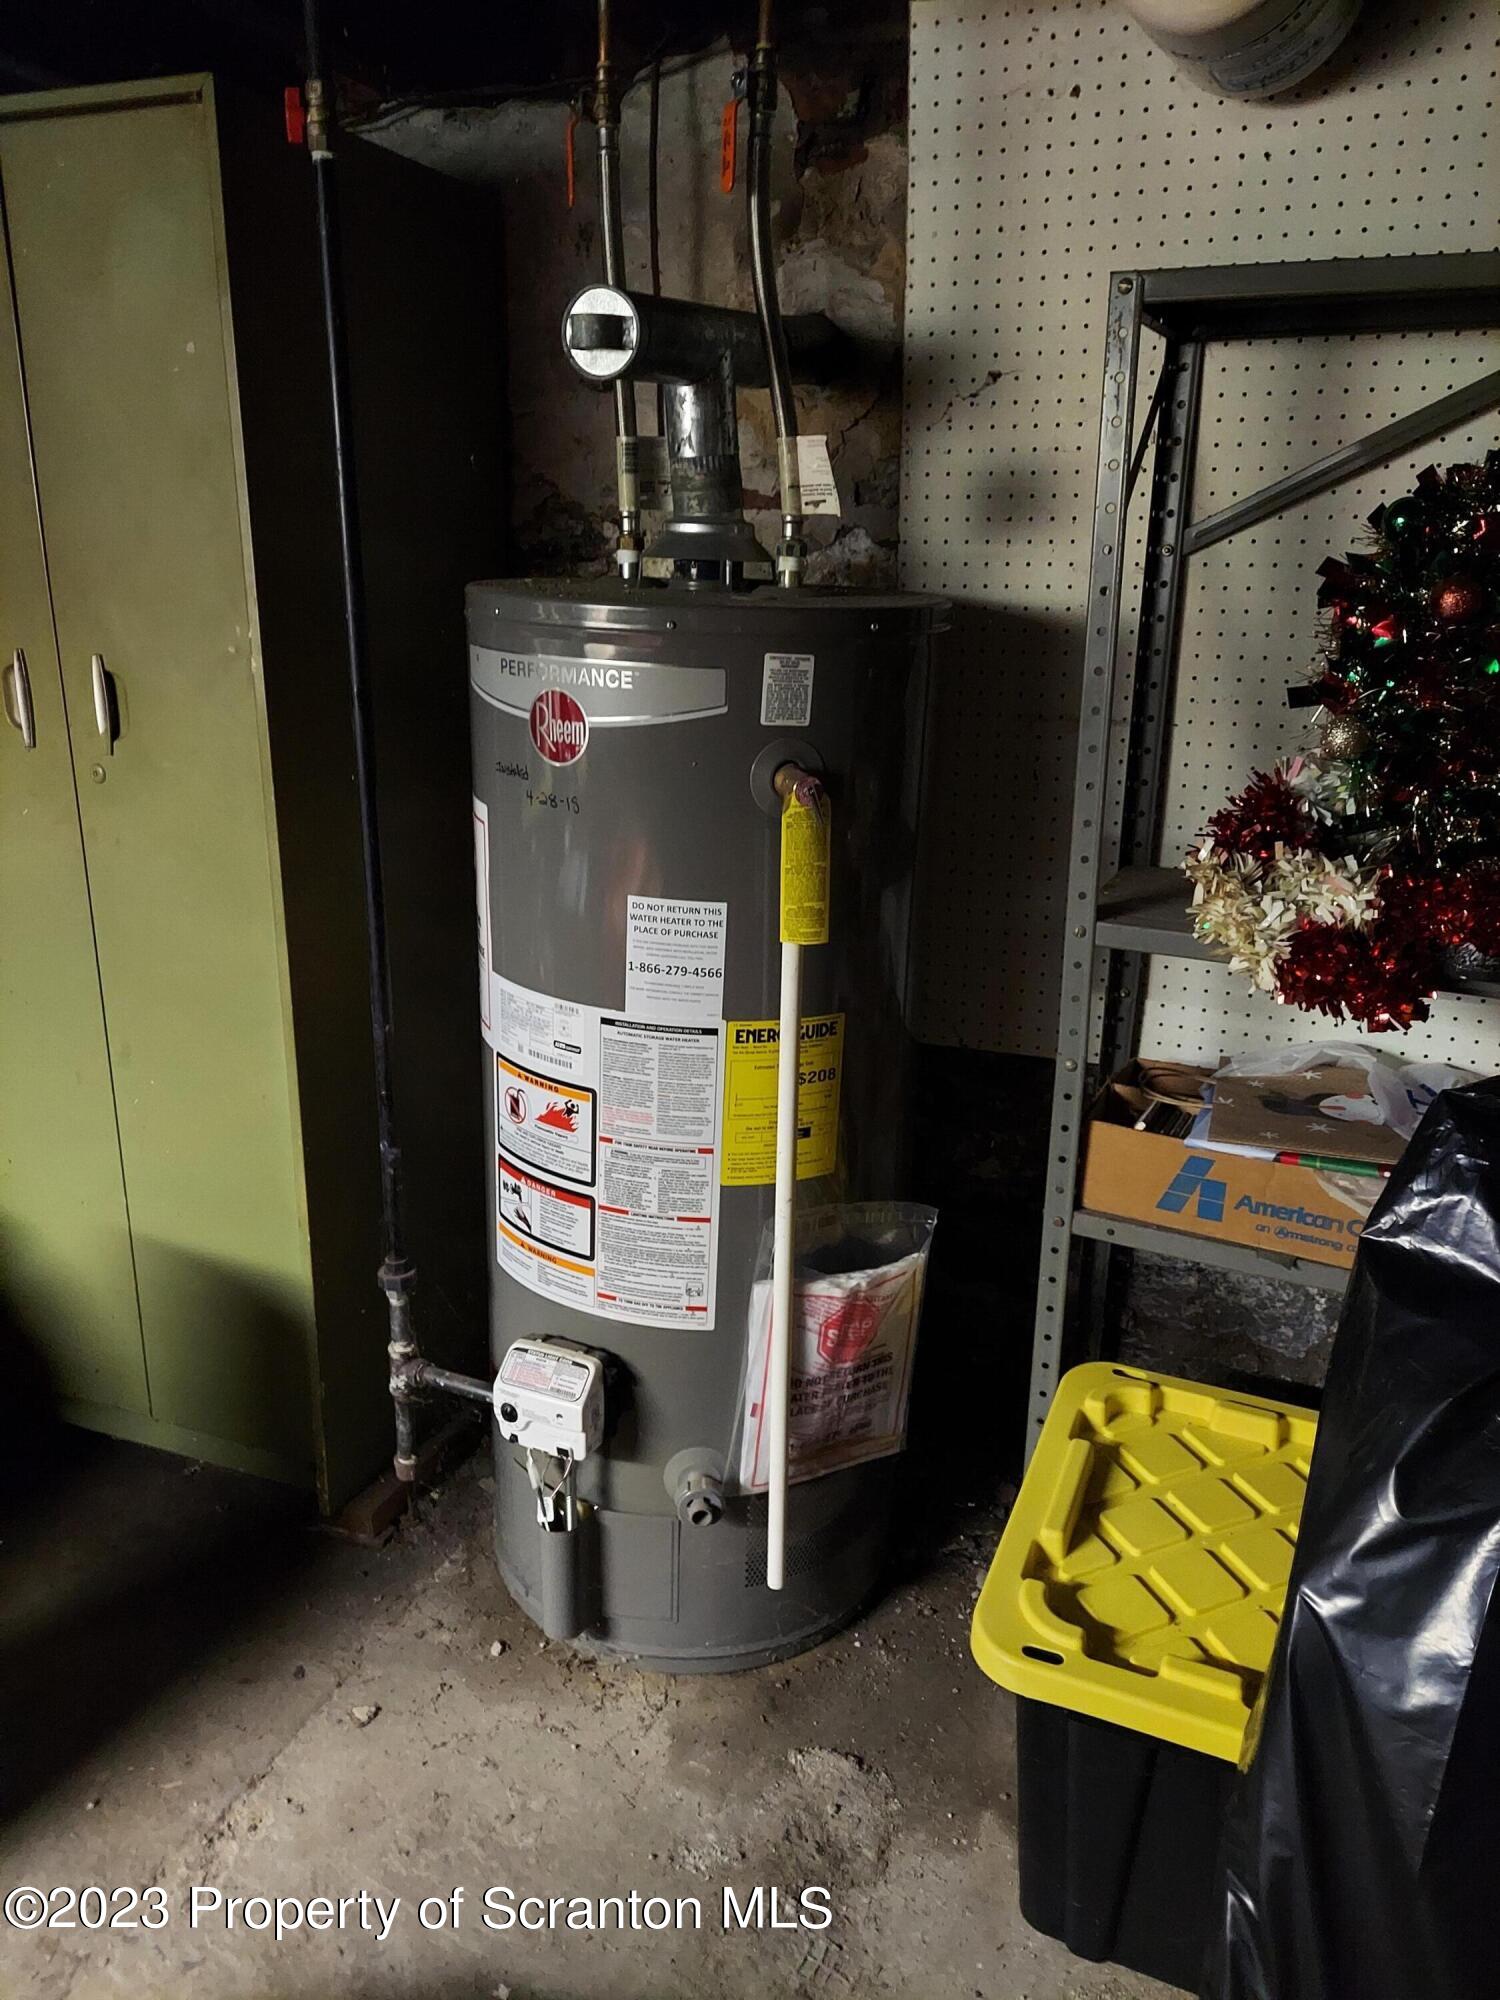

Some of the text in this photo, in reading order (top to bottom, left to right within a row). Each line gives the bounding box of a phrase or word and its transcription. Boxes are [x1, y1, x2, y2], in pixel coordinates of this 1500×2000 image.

[500, 657, 633, 690] PERFORMANCE
[535, 690, 585, 752] Rheem
[632, 901, 722, 916] DO NOT RETURN THIS
[629, 913, 724, 928] WATER HEATER TO THE
[633, 925, 719, 939] PLACE OF PURCHASE
[628, 961, 723, 979] 1-866-279-4566
[525, 1074, 559, 1093] WARNING
[526, 1180, 556, 1198] DANGER
[1234, 1194, 1345, 1235] American
[1255, 1223, 1270, 1234] an
[1274, 1226, 1343, 1251] Armstrong
[527, 1244, 558, 1264] WARNING
